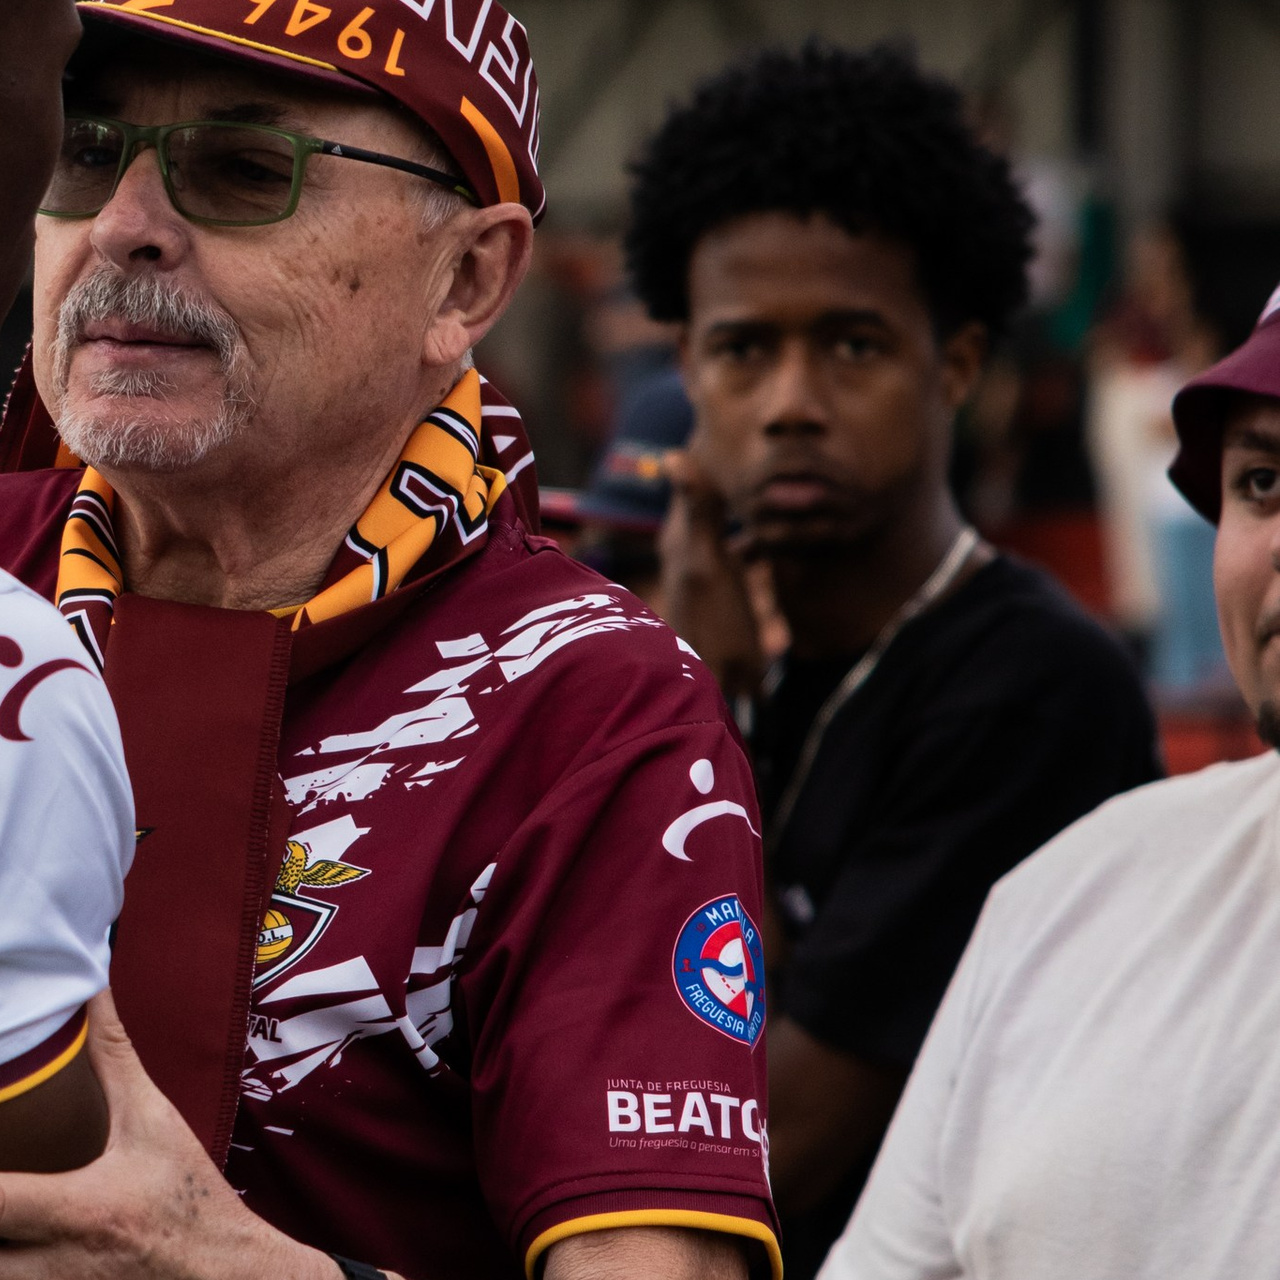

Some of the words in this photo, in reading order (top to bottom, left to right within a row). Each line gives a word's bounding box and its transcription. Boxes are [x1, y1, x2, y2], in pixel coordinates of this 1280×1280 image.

[685, 982, 745, 1036] FREGUESIA
[606, 1078, 645, 1090] JUNTA
[647, 1081, 663, 1092] DE
[666, 1079, 732, 1093] FREGUESIA
[608, 1136, 637, 1148] Uma
[639, 1136, 689, 1150] freguesia
[690, 1141, 697, 1150] a
[698, 1142, 732, 1154] pensar
[733, 1147, 750, 1157] em
